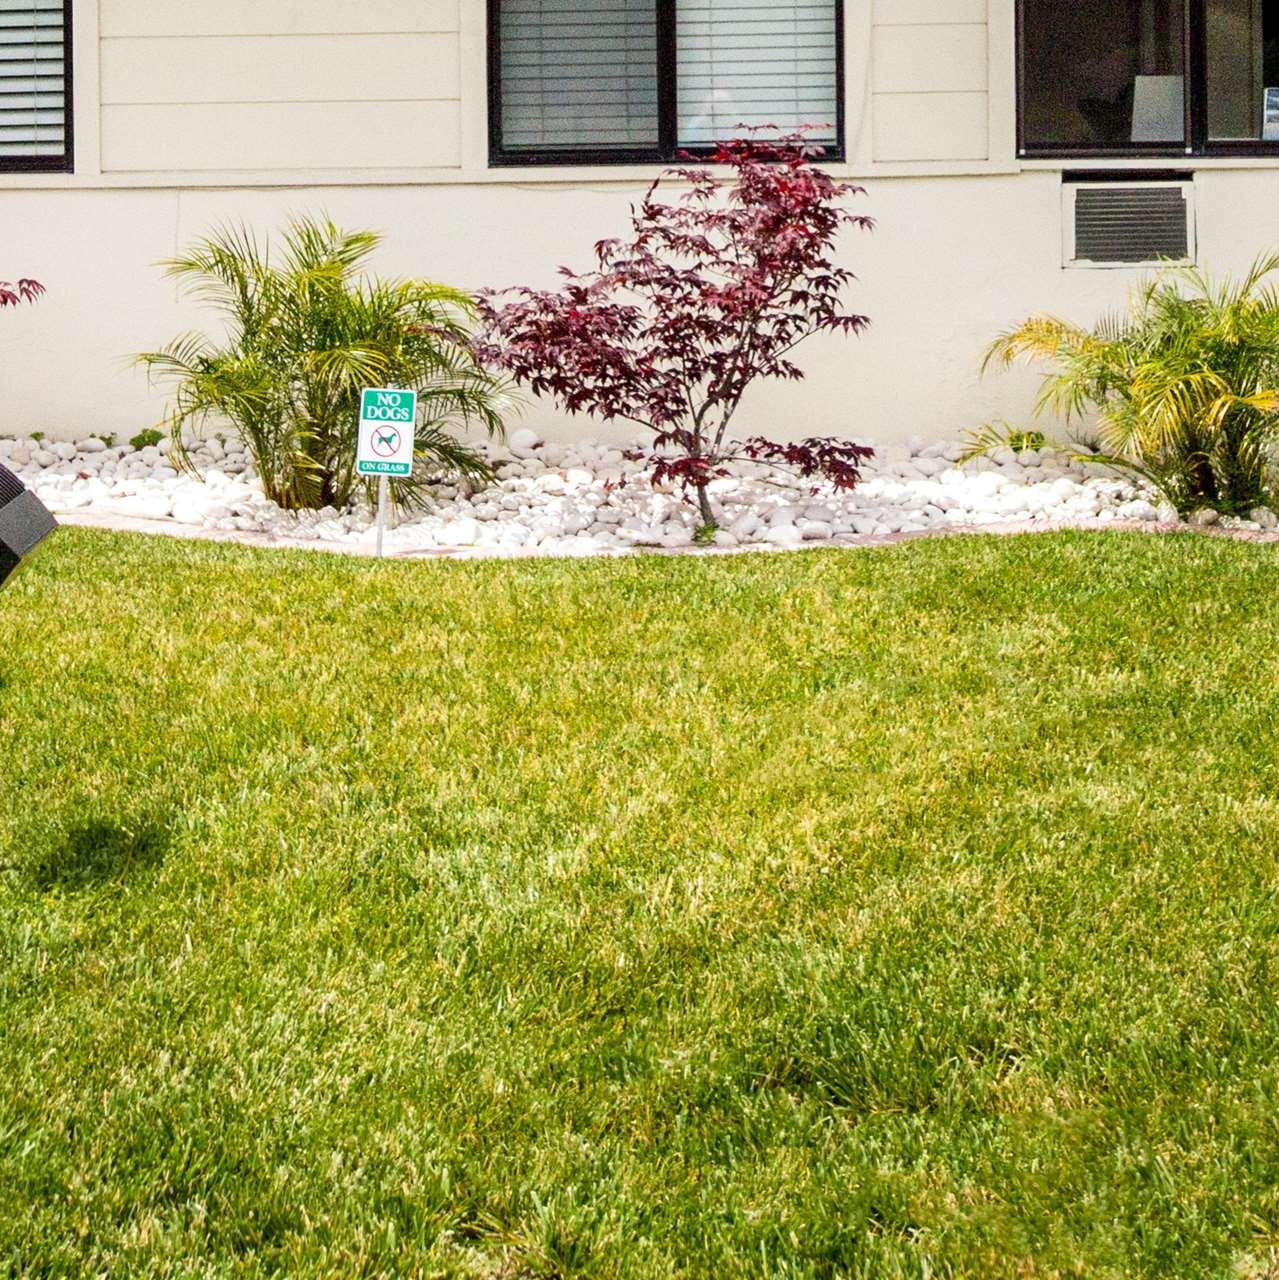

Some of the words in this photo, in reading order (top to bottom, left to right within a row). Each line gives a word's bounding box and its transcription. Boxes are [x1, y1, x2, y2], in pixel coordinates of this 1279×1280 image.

[377, 392, 401, 406] NO
[367, 405, 409, 420] DOGS
[362, 462, 375, 470] ON
[377, 463, 405, 471] GRASS
